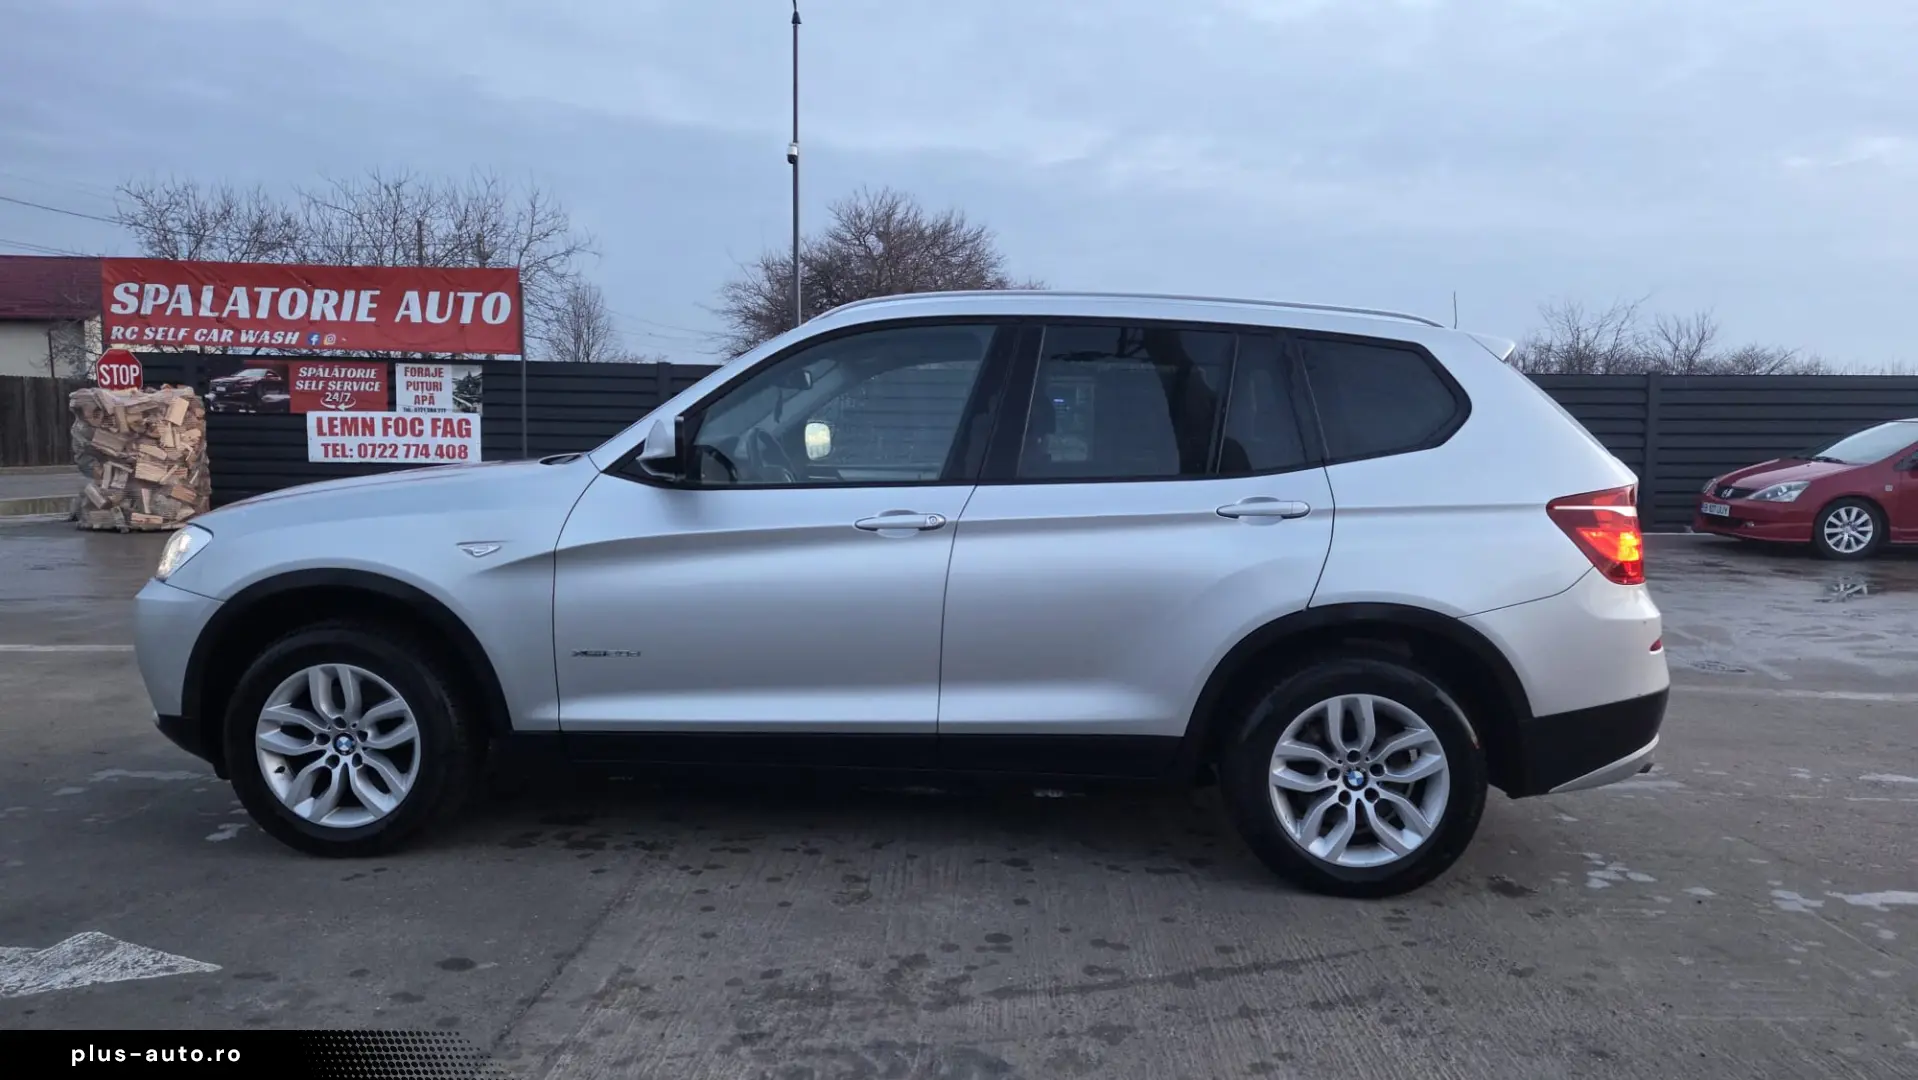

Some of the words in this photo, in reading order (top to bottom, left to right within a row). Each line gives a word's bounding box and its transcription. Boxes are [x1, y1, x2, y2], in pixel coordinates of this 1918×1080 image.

[110, 282, 381, 322] SPALATORIE
[394, 291, 512, 325] AUTO
[110, 325, 138, 341] RC
[142, 326, 190, 342] SELF
[194, 328, 234, 343] CAR
[239, 329, 300, 346] WASH
[100, 364, 140, 386] STOP
[298, 364, 378, 379] SPĂLĂTORIE
[404, 366, 444, 378] FORAJE
[295, 380, 326, 391] SELF
[327, 381, 382, 392] SERVICE
[324, 392, 351, 402] 24/7
[414, 392, 435, 405] APĂ
[315, 416, 376, 437] LEMN
[381, 417, 424, 438] FOC
[430, 417, 472, 439] FAG
[321, 443, 353, 458] TEL:
[357, 443, 399, 459] 0722
[402, 443, 431, 459] 774
[434, 444, 468, 460] 408
